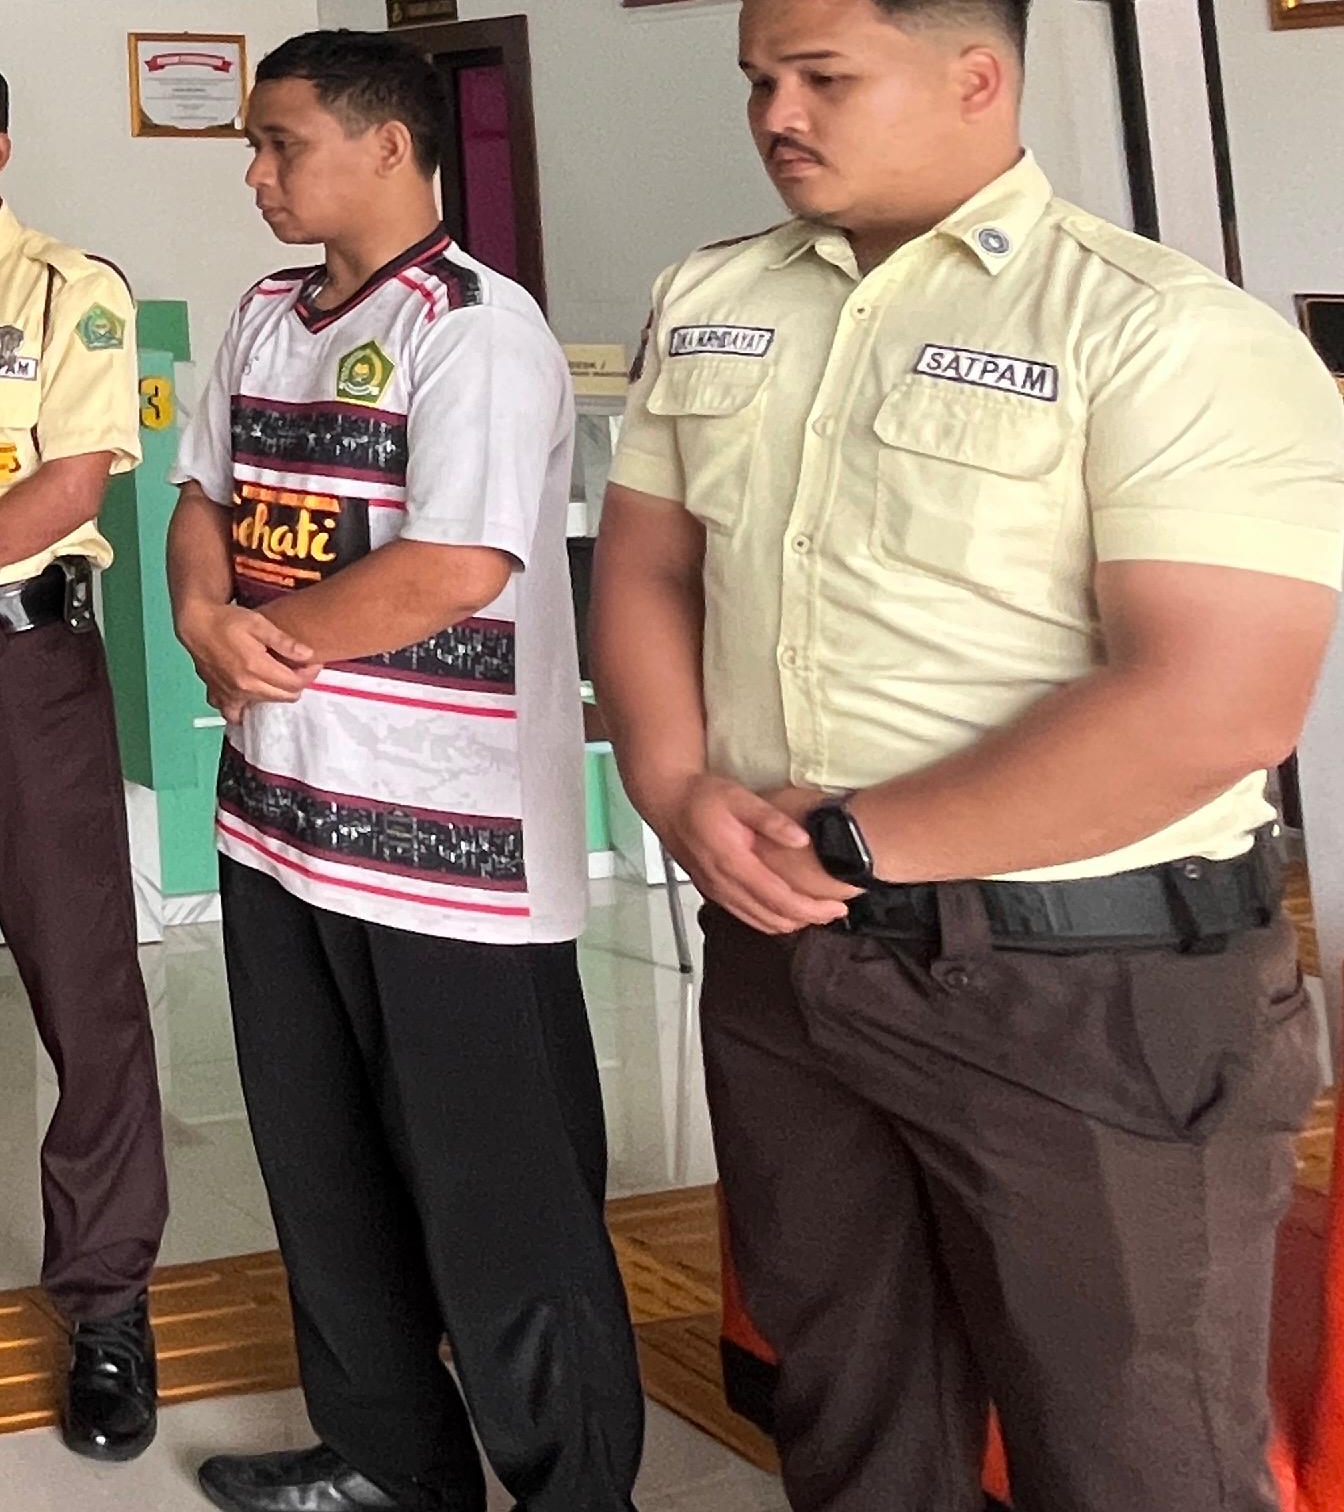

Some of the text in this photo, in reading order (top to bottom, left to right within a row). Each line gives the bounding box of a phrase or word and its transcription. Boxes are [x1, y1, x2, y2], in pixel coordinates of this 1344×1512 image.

[926, 351, 1050, 393] SATPAM
[139, 376, 175, 431] 3
[233, 491, 338, 562] ehati
